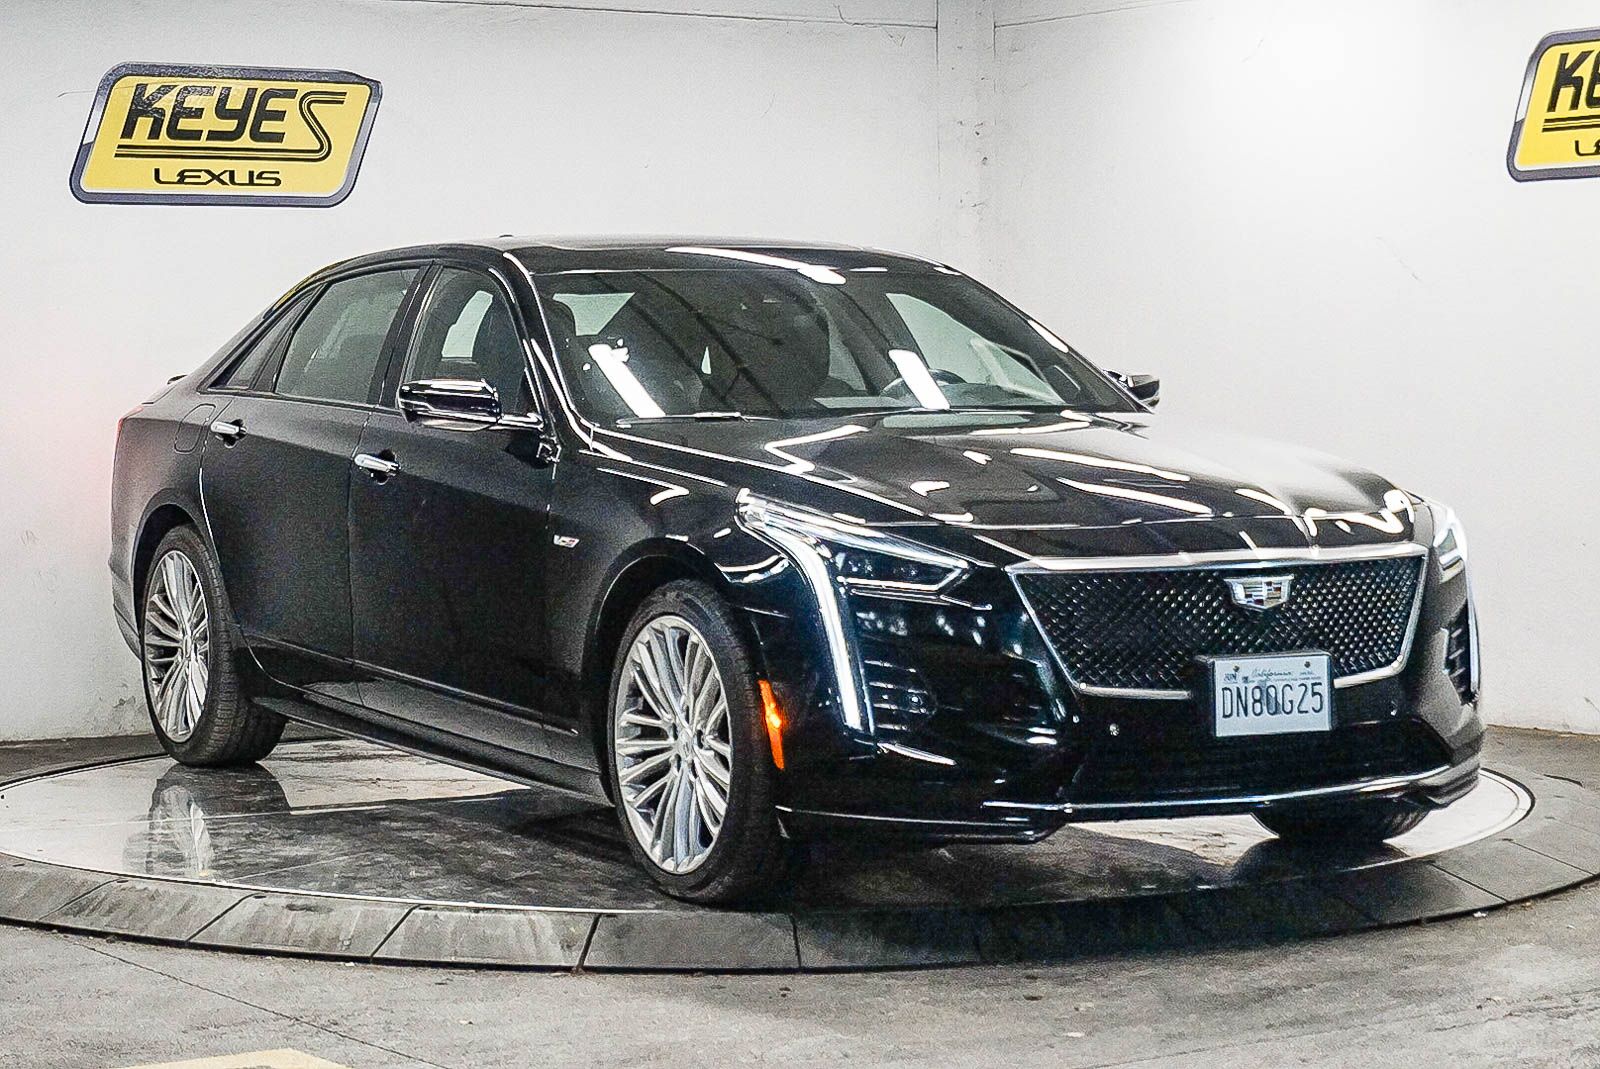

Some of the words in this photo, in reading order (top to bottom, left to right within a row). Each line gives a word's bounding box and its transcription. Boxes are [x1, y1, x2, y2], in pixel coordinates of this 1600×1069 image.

[120, 82, 347, 162] KEYES
[154, 168, 282, 187] LEXUS
[1221, 682, 1323, 718] DN80G25
